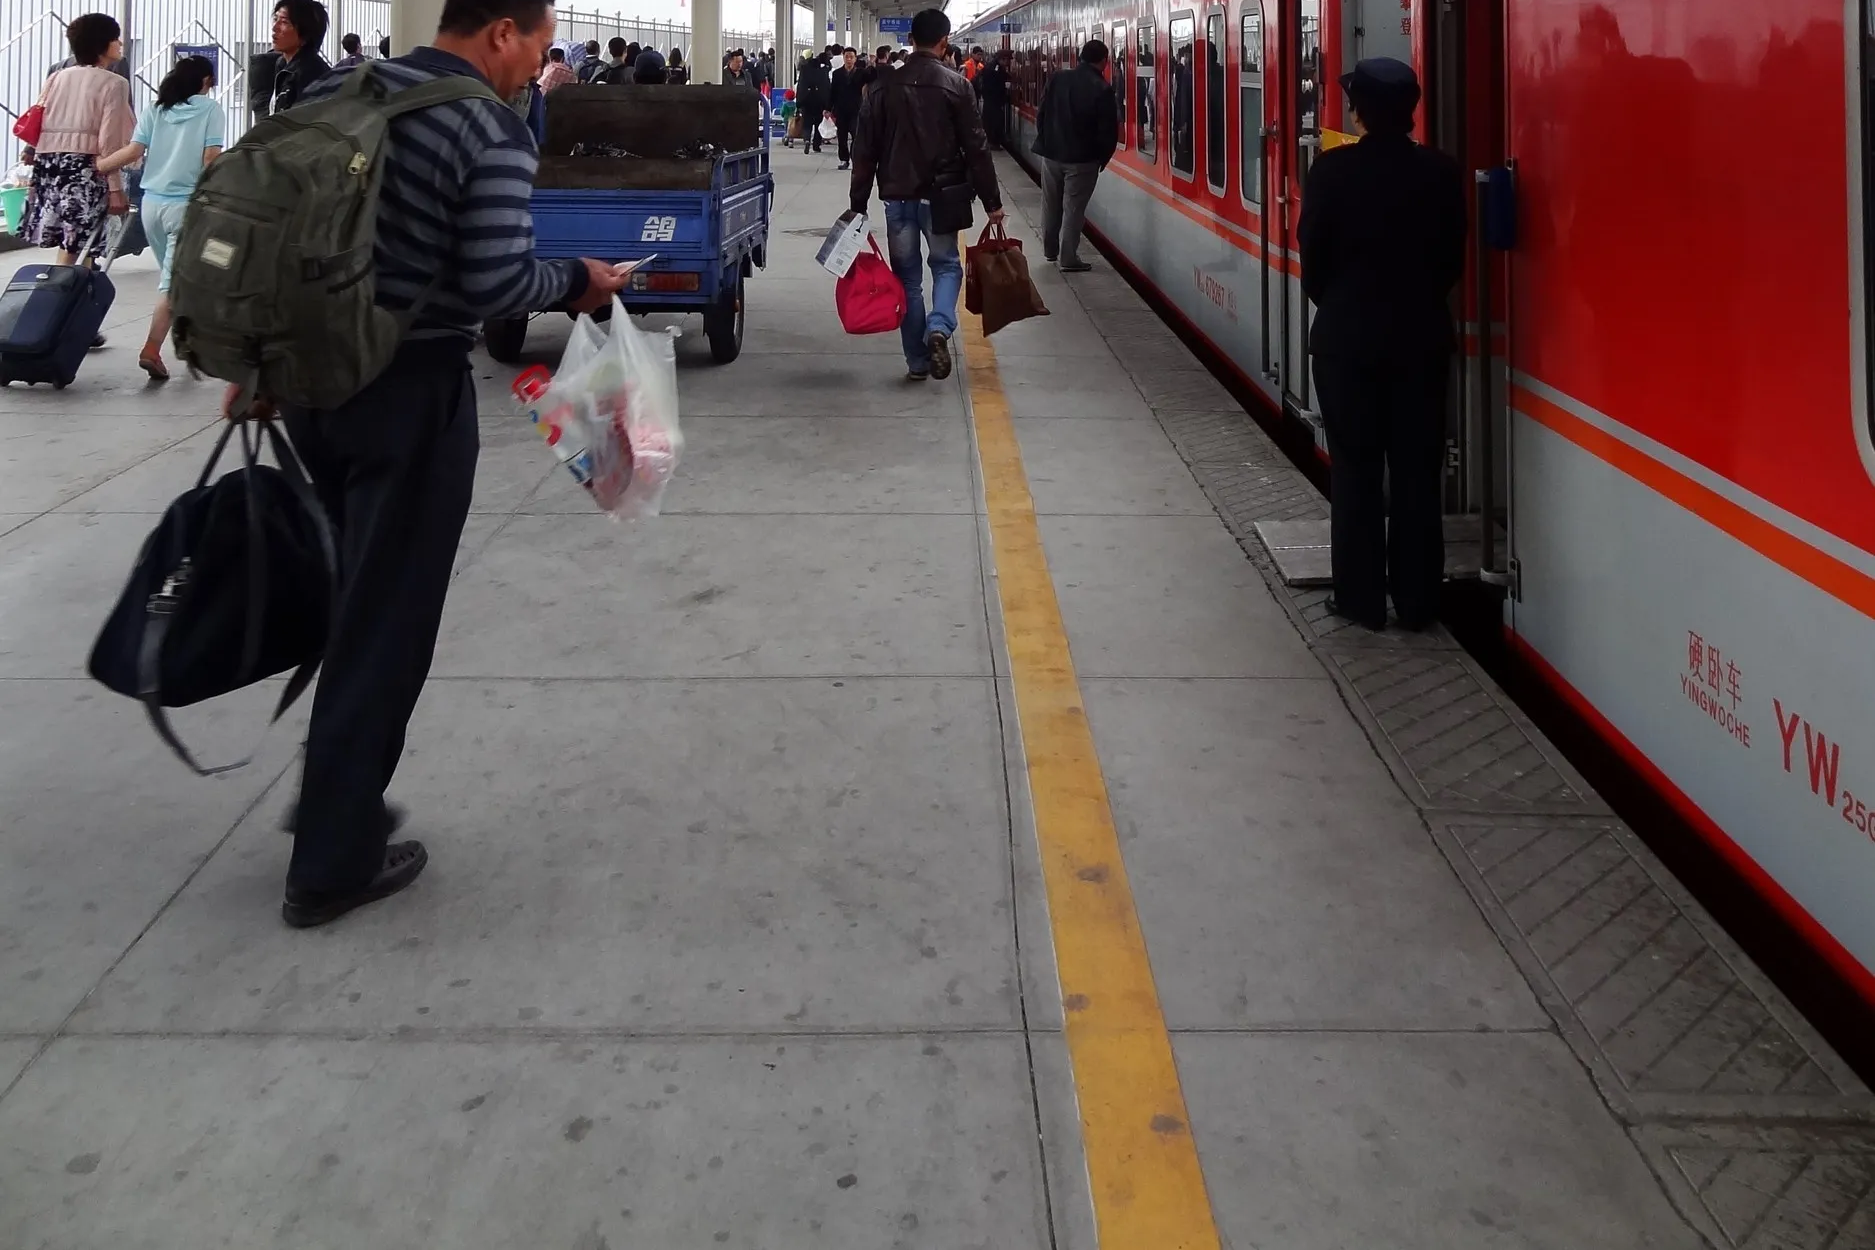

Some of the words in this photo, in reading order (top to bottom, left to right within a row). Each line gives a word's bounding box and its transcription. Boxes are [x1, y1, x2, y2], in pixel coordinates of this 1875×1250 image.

[1688, 630, 1742, 709] 硬卧车
[1680, 673, 1751, 748] YINGWOCHE
[1773, 698, 1840, 807] YW
